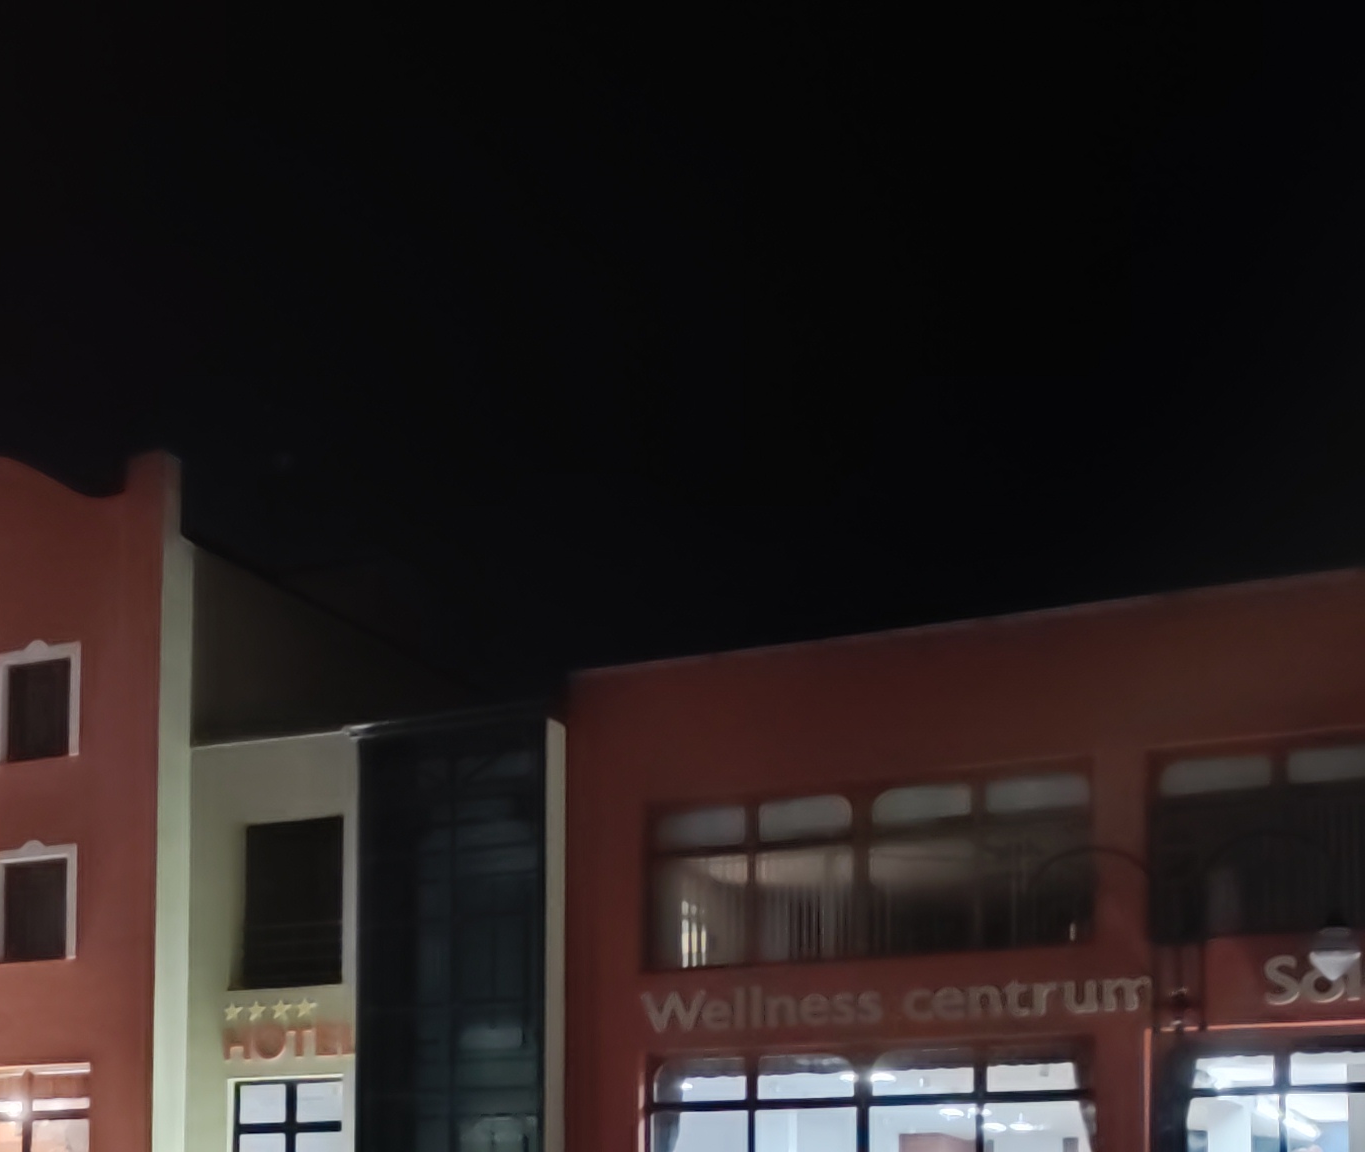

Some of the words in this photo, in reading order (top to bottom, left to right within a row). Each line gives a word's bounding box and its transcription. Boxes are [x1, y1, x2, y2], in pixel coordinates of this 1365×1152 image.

[641, 985, 884, 1033] Wellness
[904, 976, 1154, 1021] centrum
[221, 1022, 355, 1061] HOTEL
